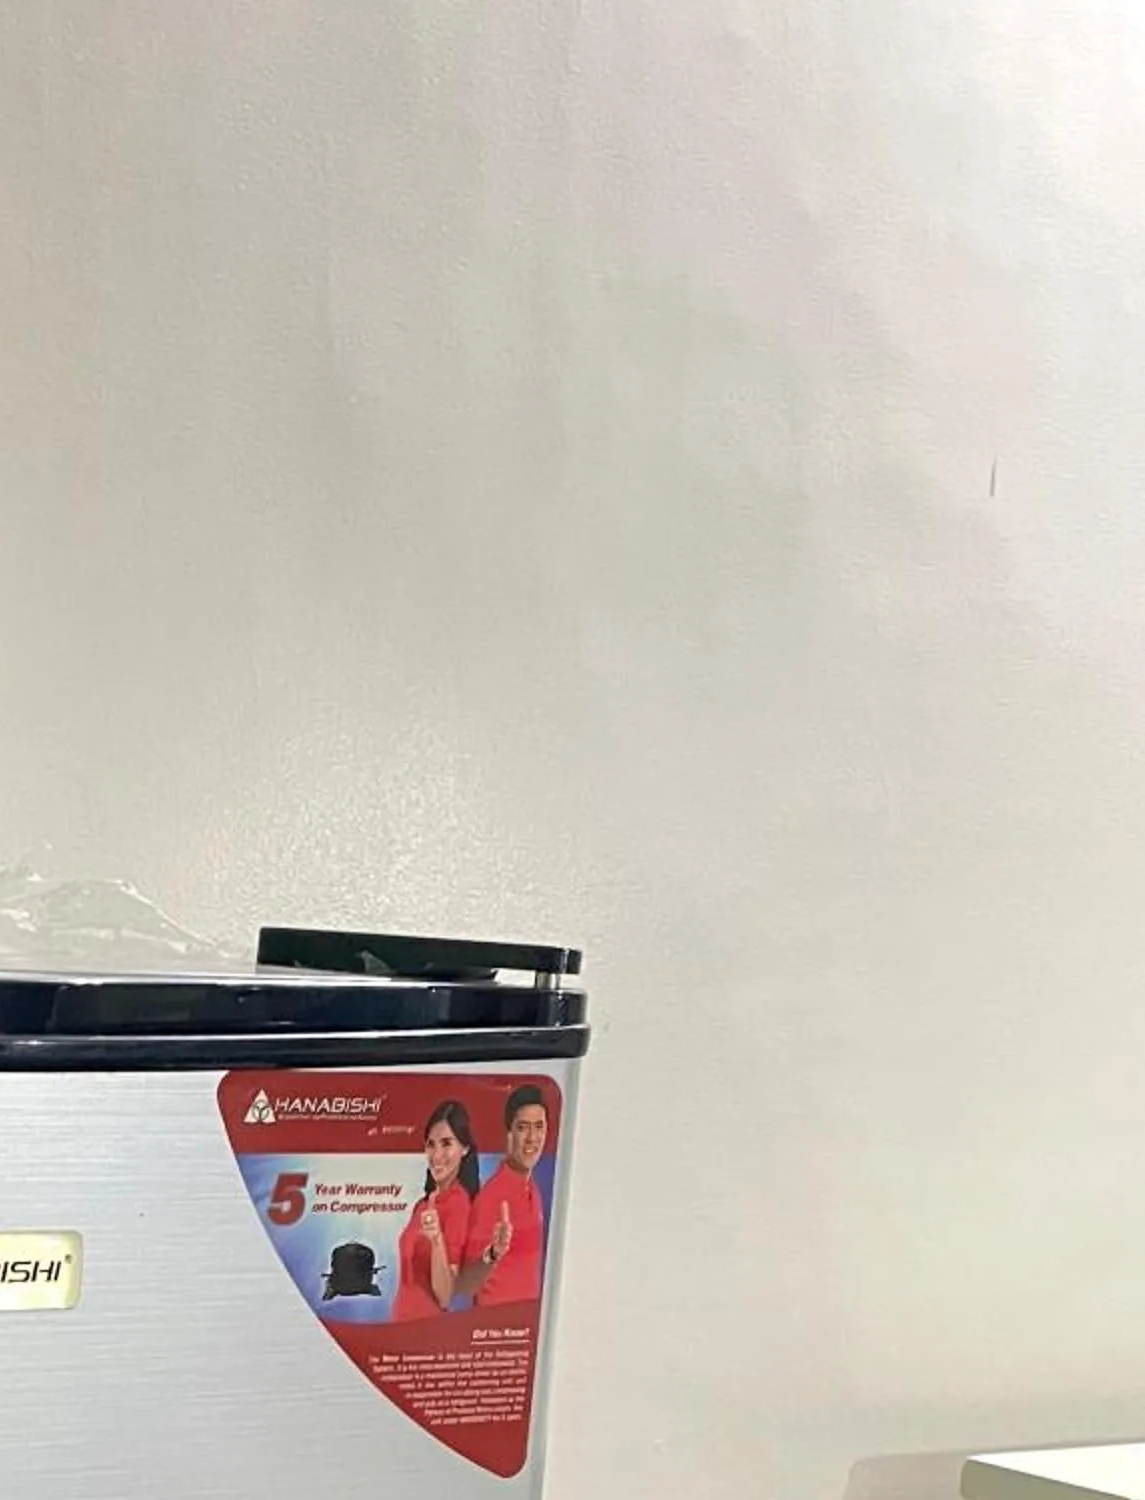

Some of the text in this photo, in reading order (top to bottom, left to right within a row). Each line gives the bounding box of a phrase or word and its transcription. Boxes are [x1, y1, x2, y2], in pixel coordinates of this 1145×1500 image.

[275, 1096, 382, 1113] HANABISHI
[315, 1183, 402, 1198] Year Warranty
[266, 1172, 309, 1226] 5
[312, 1200, 407, 1216] on Compressor
